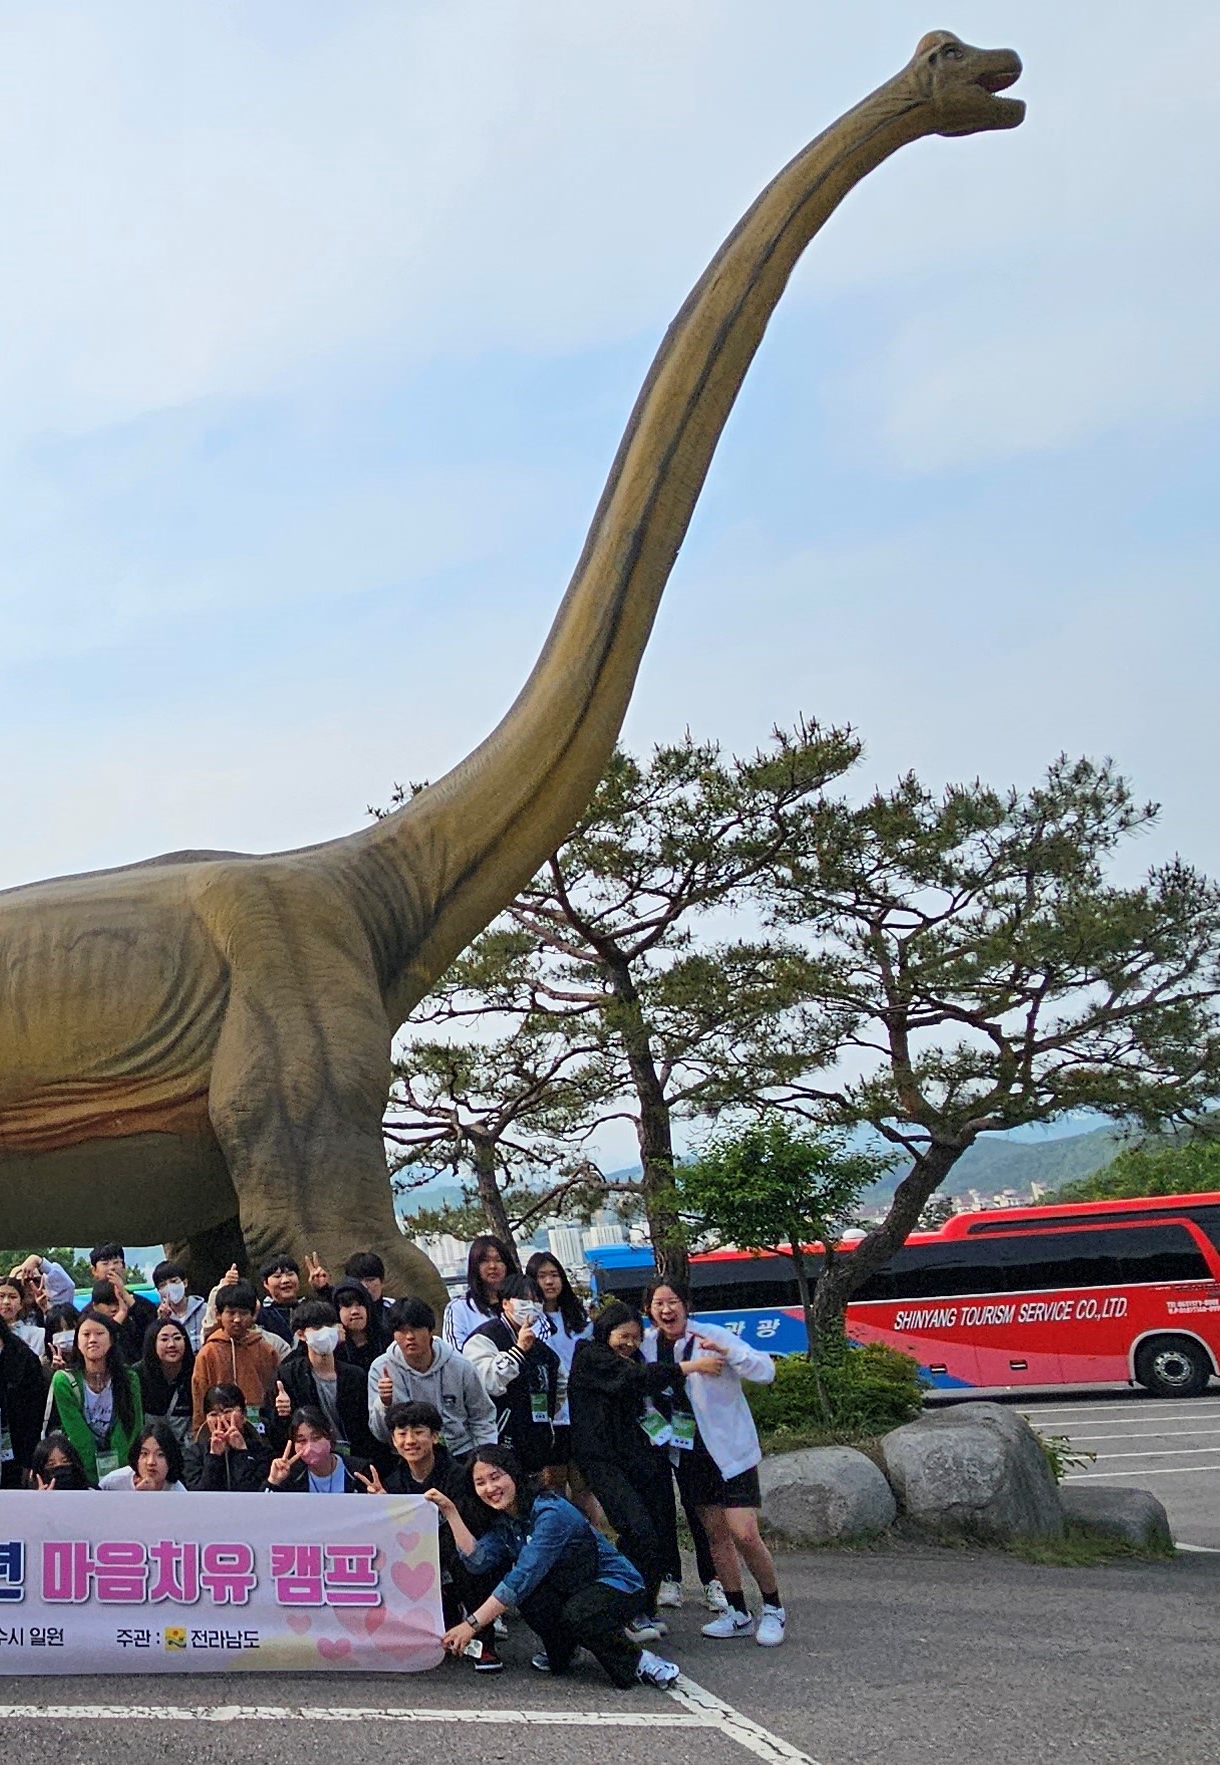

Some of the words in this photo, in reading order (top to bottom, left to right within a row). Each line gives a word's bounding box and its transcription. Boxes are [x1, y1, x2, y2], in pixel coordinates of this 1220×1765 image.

[894, 1307, 957, 1330] SHINYANG
[960, 1304, 1016, 1326] TOURISM
[1018, 1300, 1074, 1323] SERVICE
[1075, 1297, 1128, 1321] CO.,LTD.
[42, 1540, 257, 1606] 마음치유
[270, 1542, 382, 1608] 캠프
[29, 1627, 64, 1647] 일원
[116, 1628, 152, 1648] 주관
[190, 1629, 261, 1649] 전라남도
